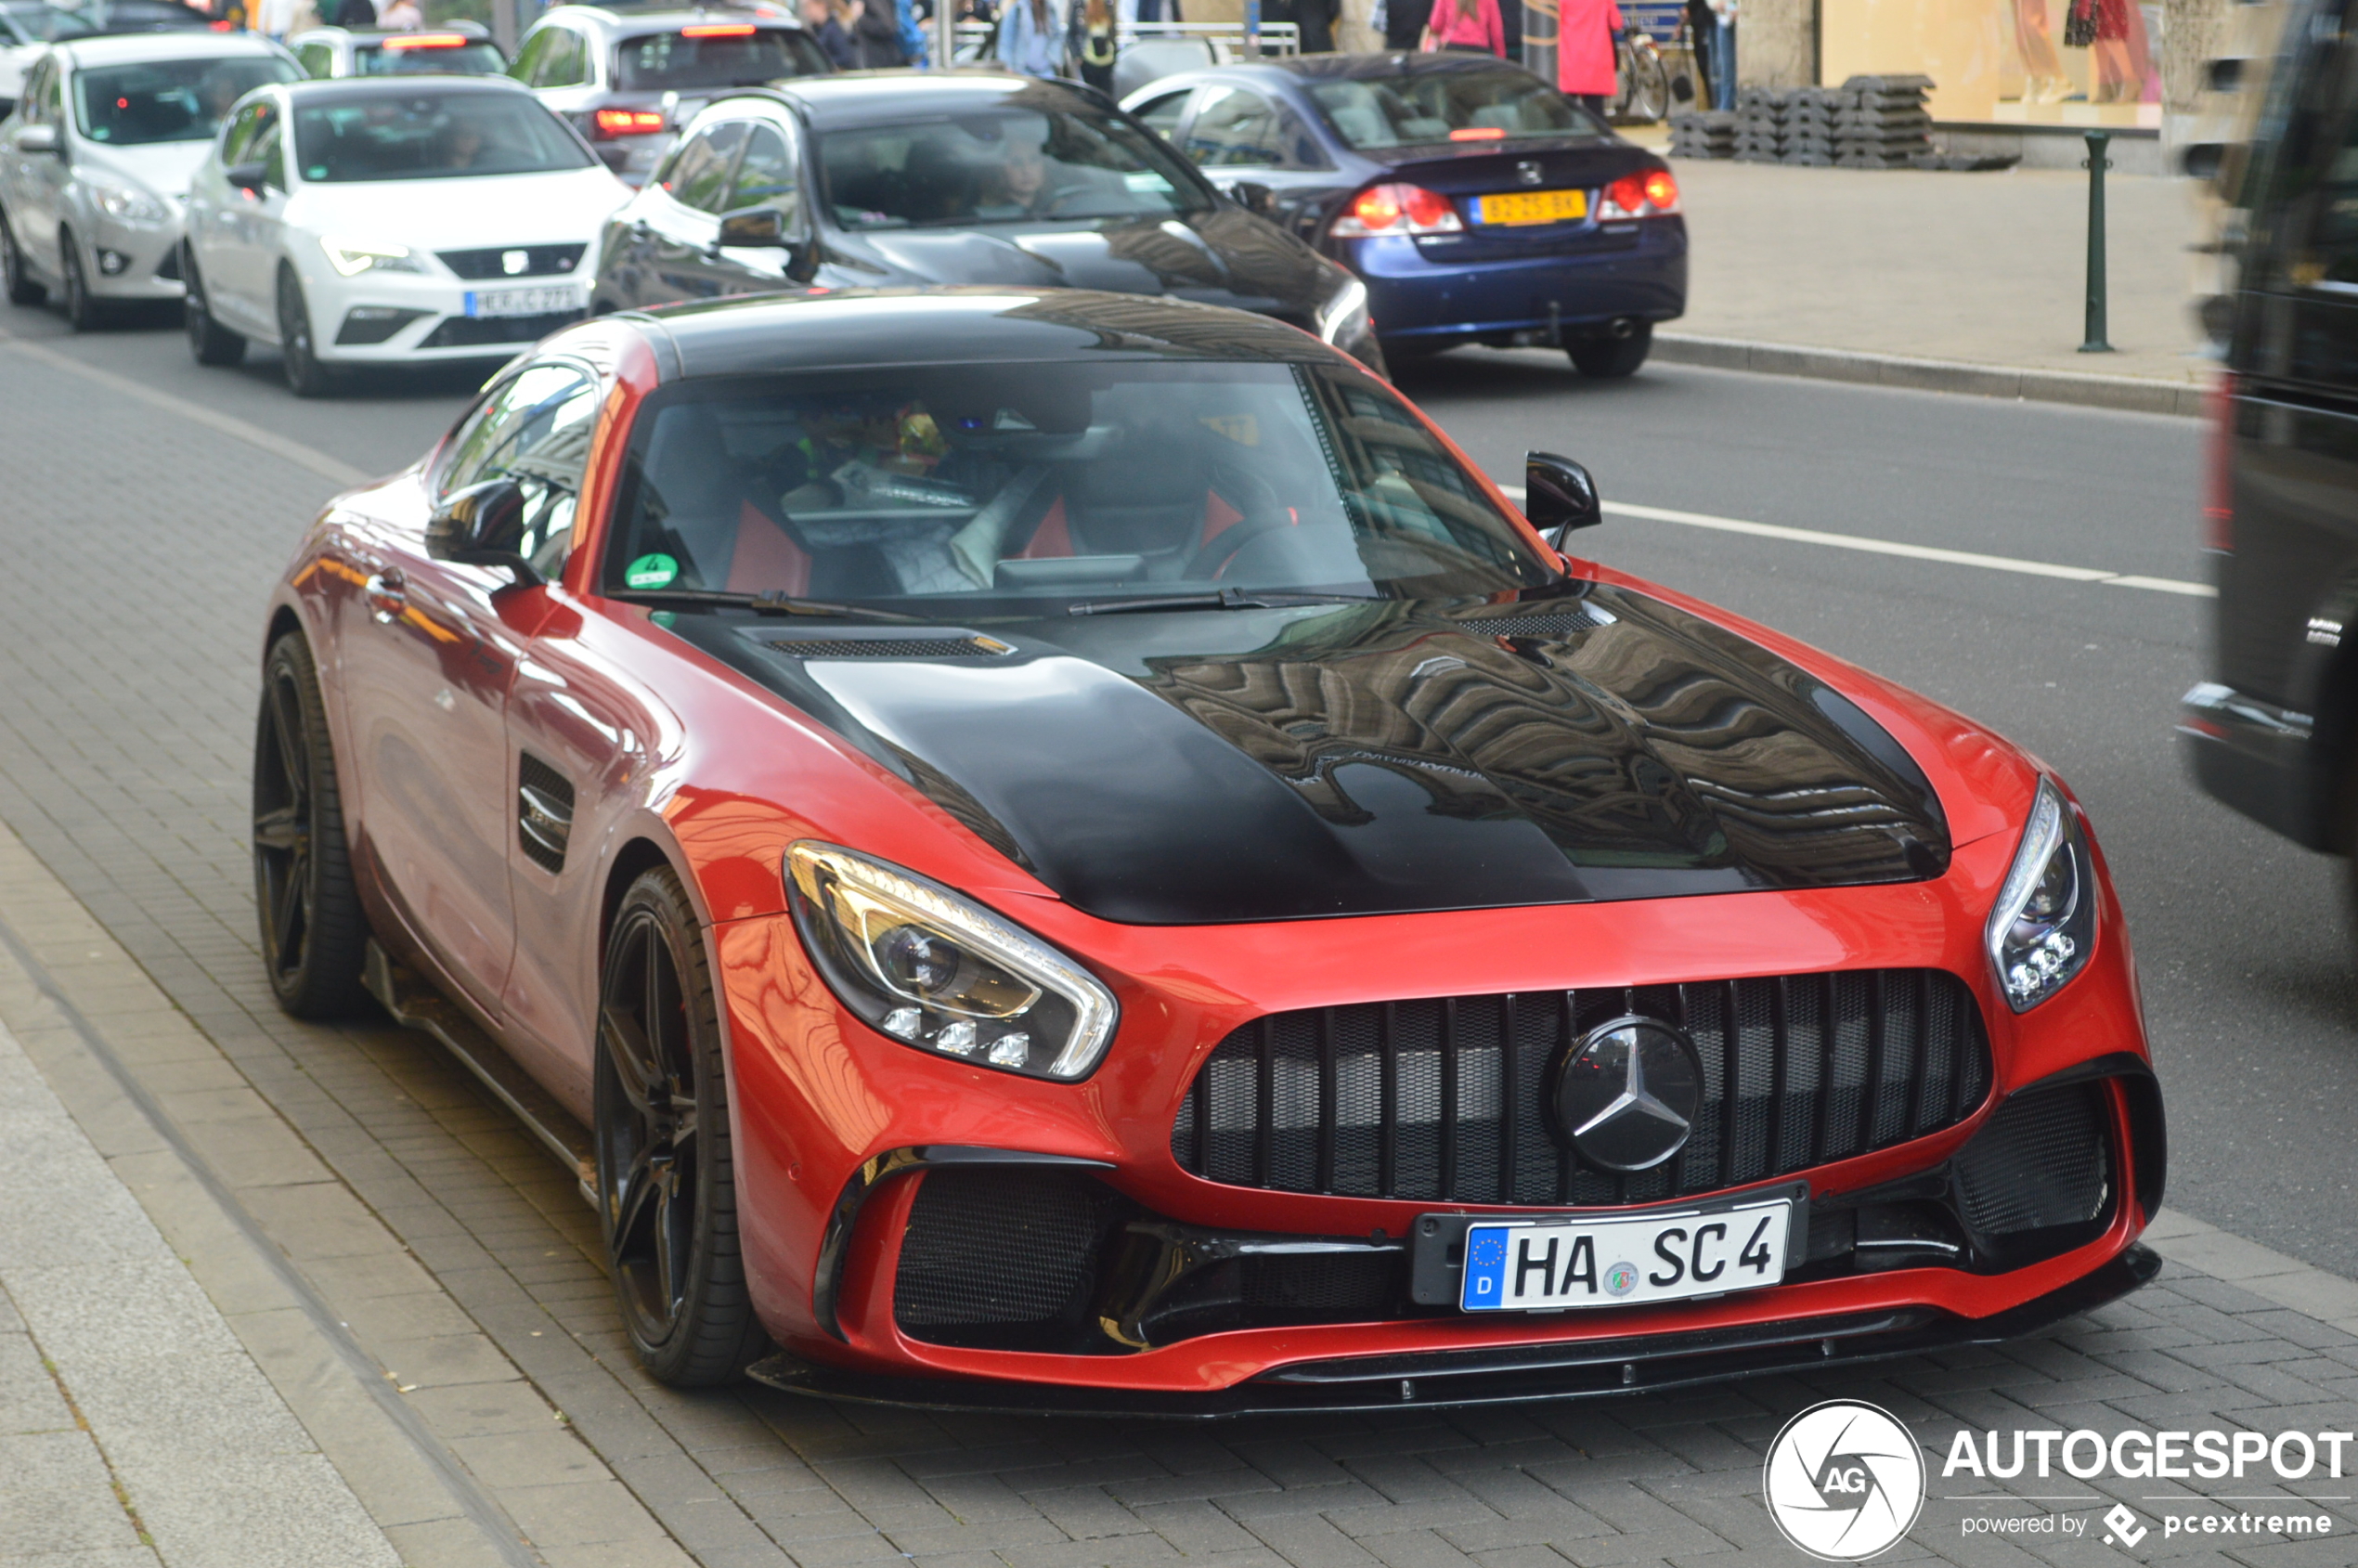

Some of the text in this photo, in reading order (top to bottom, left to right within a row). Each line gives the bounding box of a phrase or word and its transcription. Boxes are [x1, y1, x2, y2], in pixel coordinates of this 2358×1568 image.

[1514, 1235, 1599, 1298] HA
[1649, 1222, 1728, 1288] SC
[1738, 1214, 1773, 1276] 4
[1476, 1276, 1493, 1295] D
